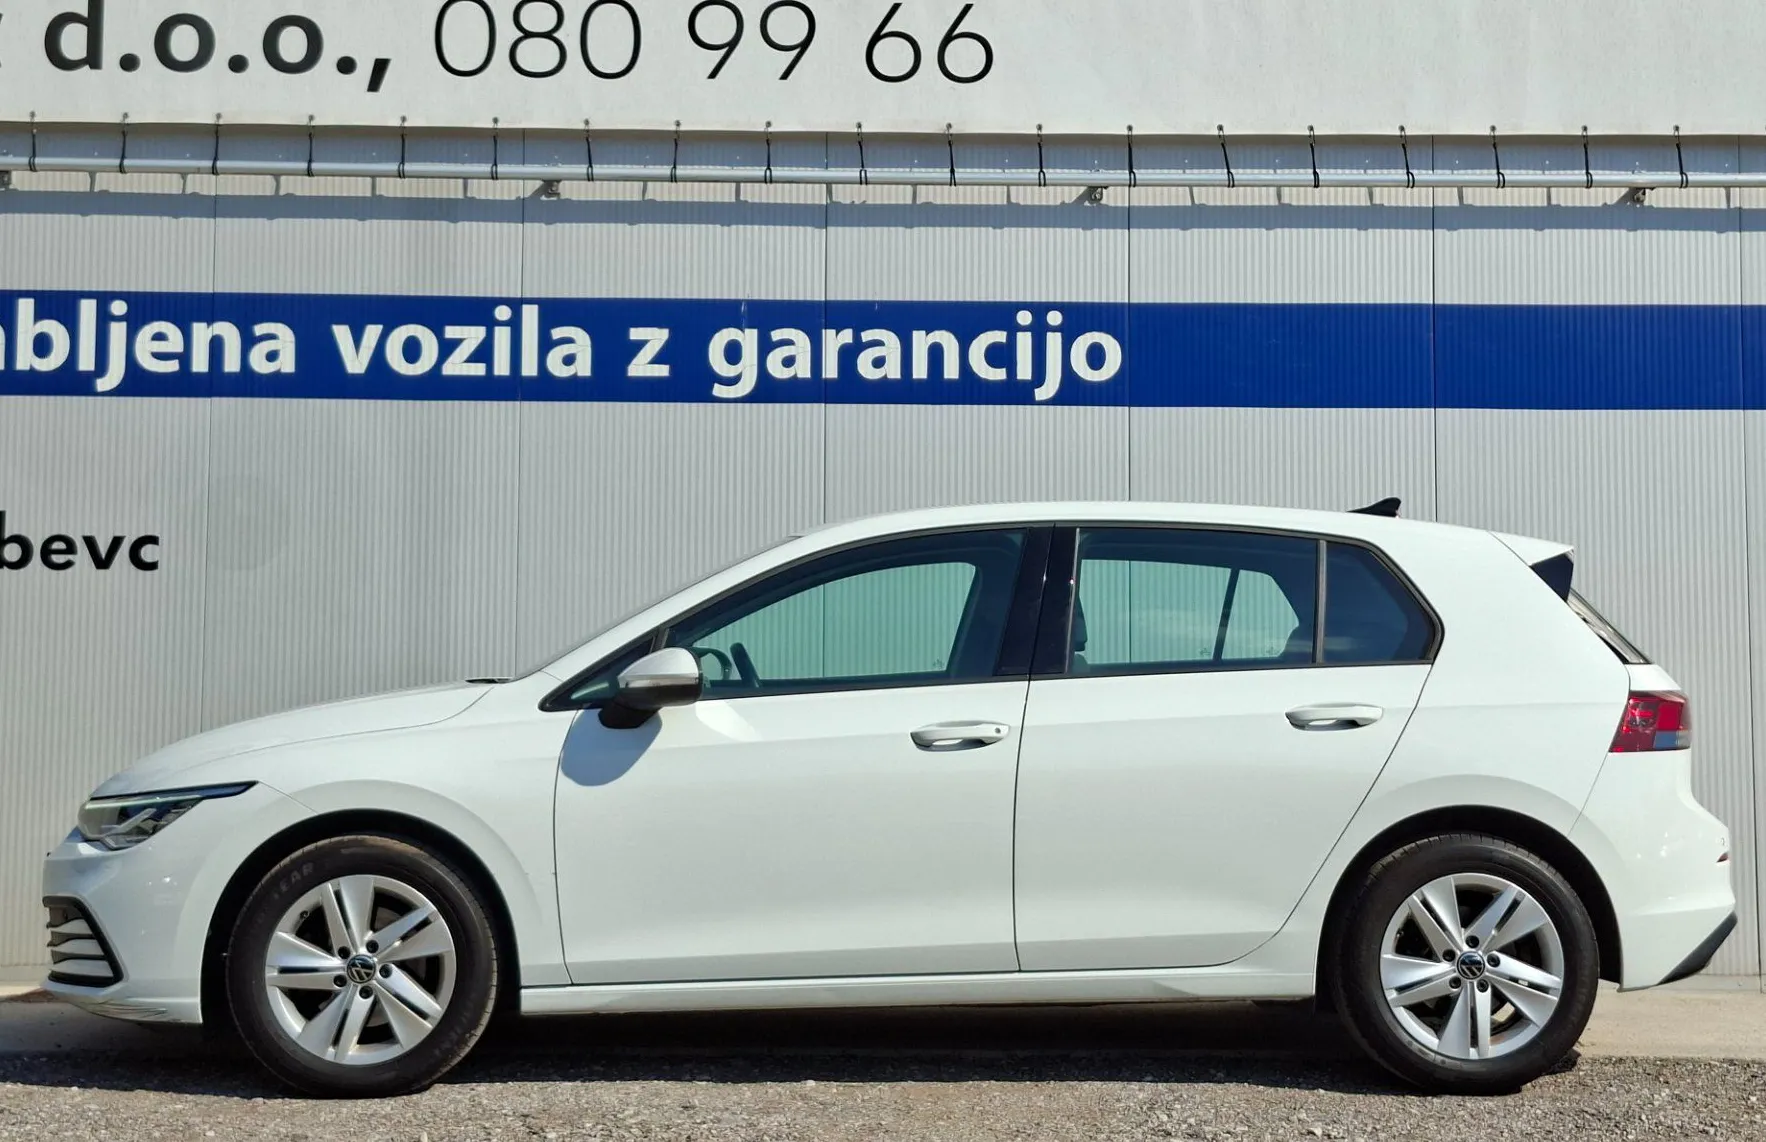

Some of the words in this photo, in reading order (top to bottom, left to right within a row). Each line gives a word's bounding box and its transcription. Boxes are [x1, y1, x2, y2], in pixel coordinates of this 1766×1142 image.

[44, 0, 391, 93] d.o.o.,
[435, 0, 641, 80] 080
[688, 0, 816, 81] 99
[865, 3, 993, 84] 66
[0, 297, 295, 393] bljena
[332, 303, 591, 378] vozila
[628, 328, 669, 377] z
[708, 310, 1122, 401] garancijo
